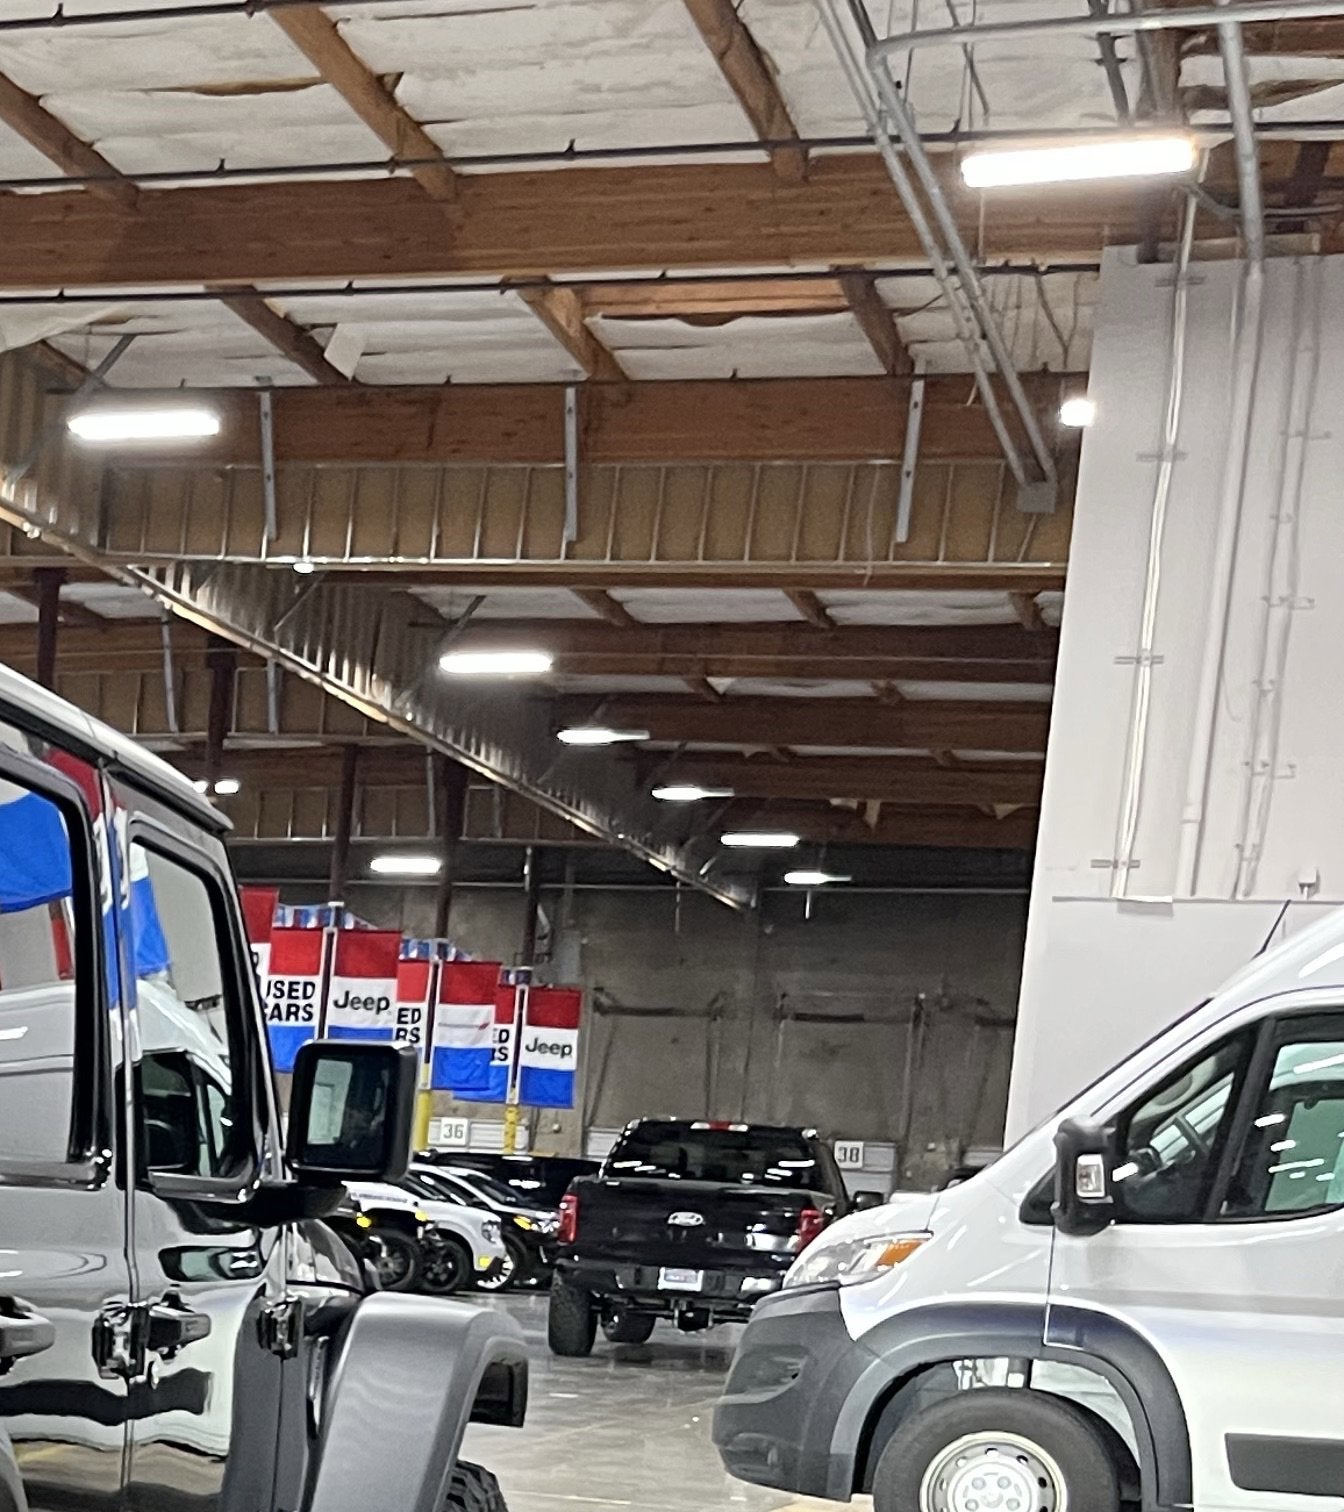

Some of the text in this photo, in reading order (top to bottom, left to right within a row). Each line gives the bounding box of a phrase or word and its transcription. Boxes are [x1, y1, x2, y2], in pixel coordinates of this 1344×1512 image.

[333, 990, 391, 1015] Jeep
[525, 1037, 573, 1059] Jeep
[443, 1123, 464, 1139] 36
